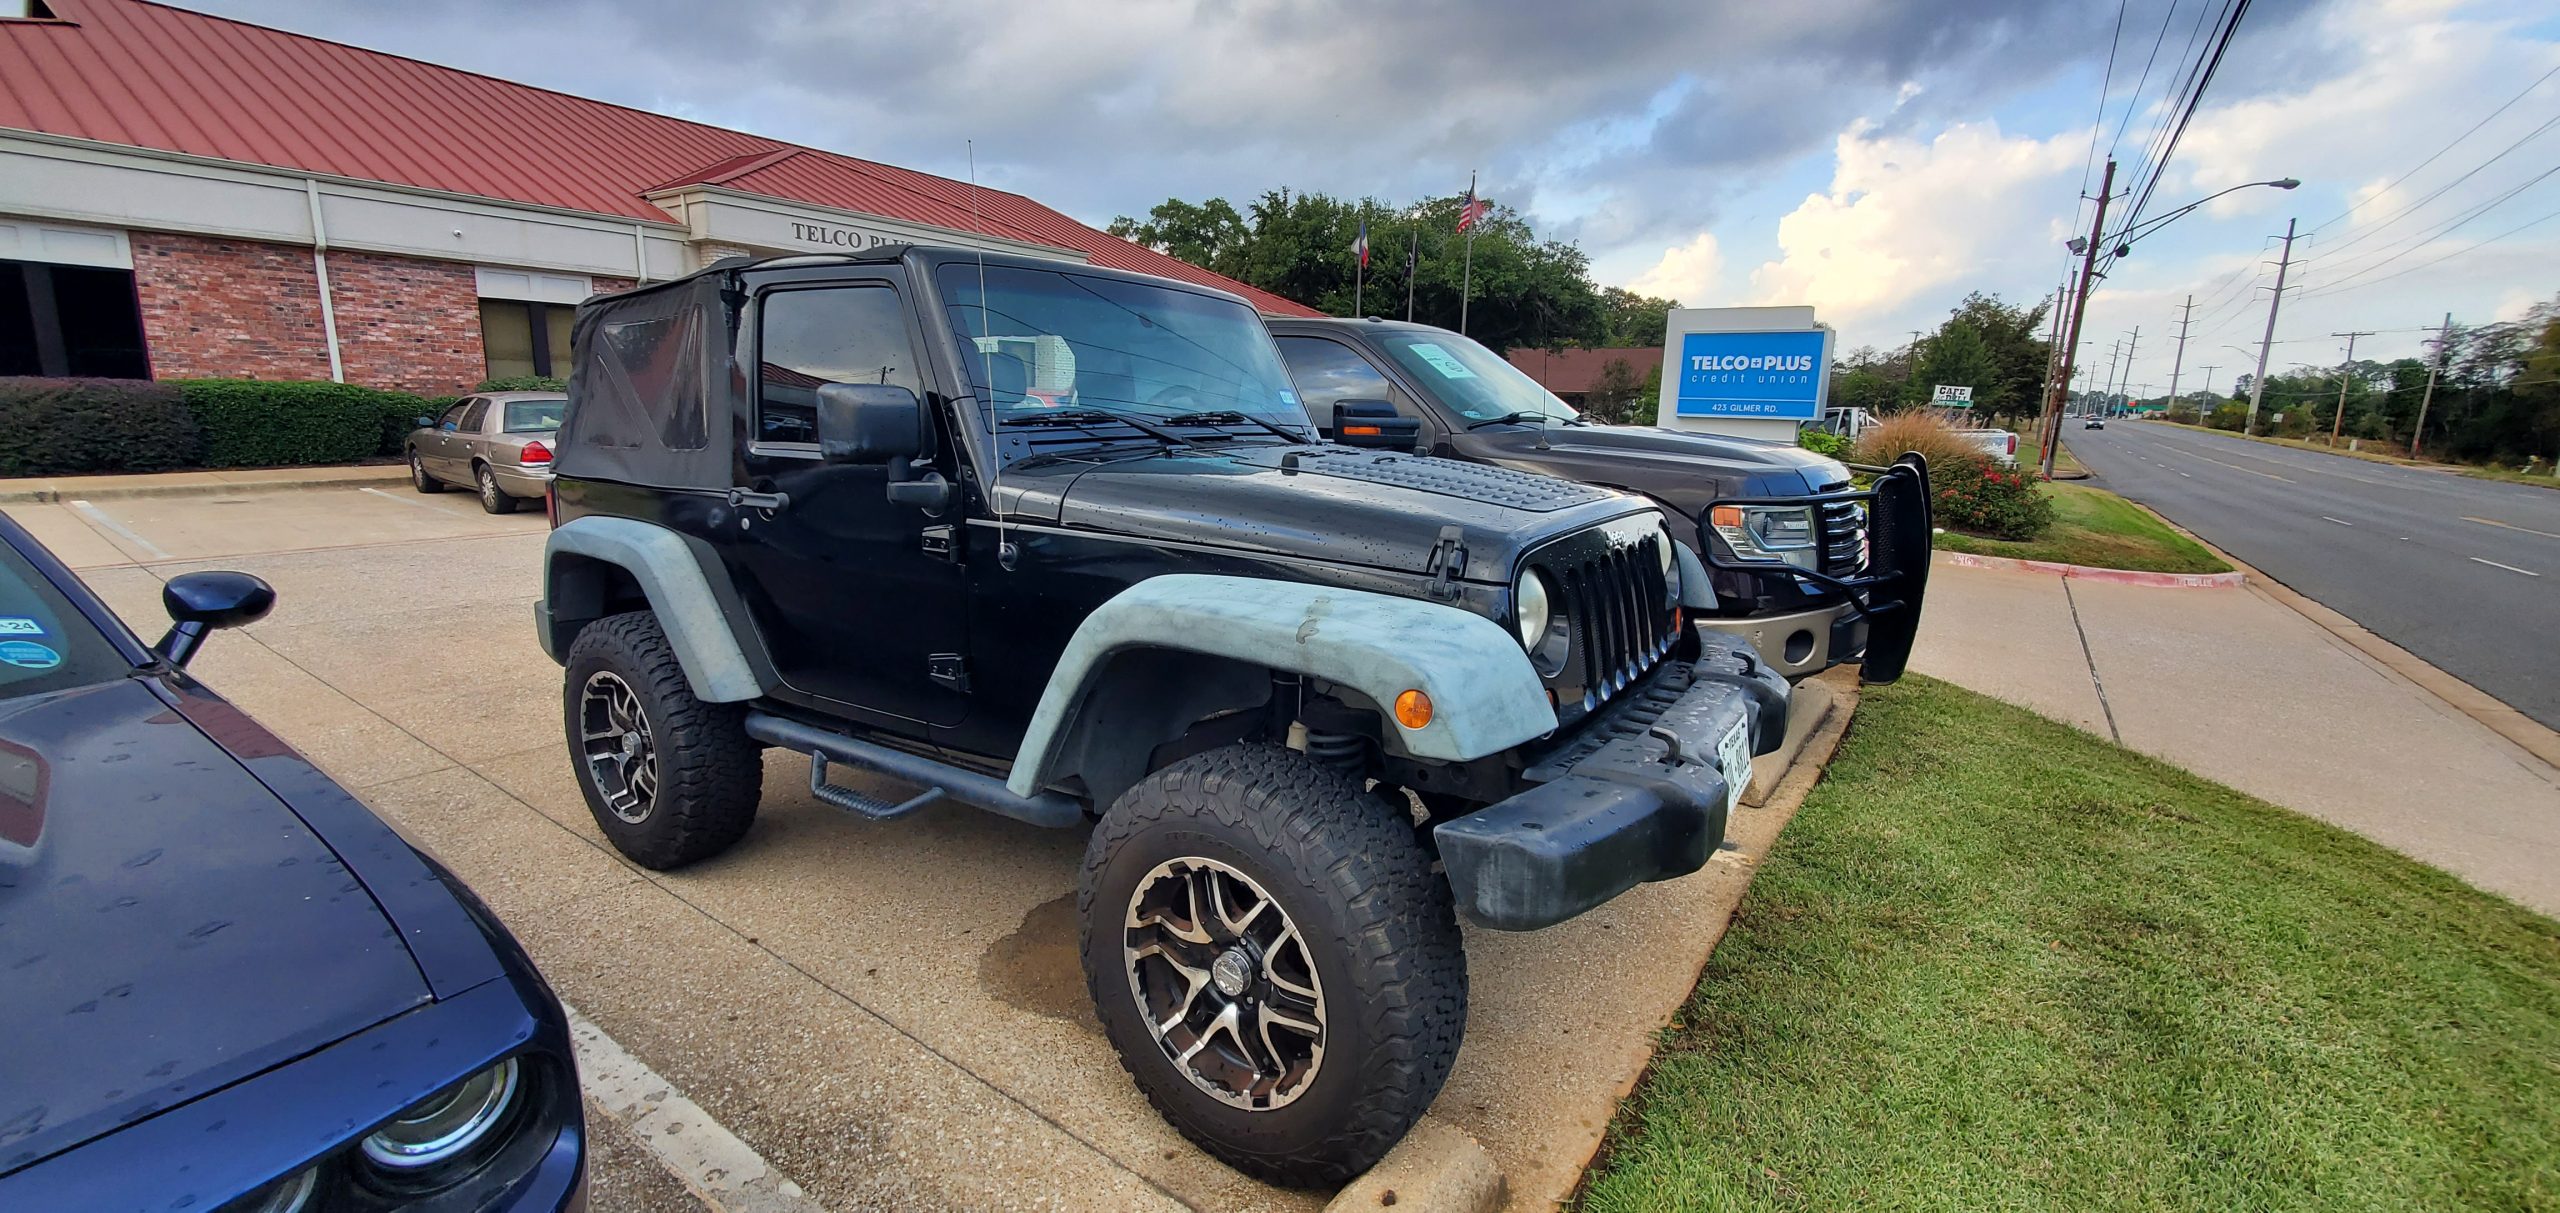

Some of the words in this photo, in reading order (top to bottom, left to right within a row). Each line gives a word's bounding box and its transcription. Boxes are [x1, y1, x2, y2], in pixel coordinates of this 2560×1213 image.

[791, 222, 862, 248] TELCO
[1691, 355, 1750, 371] TELCO
[1763, 355, 1812, 371] PLUS
[1691, 373, 1745, 383] credit
[1758, 374, 1808, 384] union
[1939, 386, 1966, 396] CAFE
[1711, 403, 1727, 412] 423
[1730, 404, 1761, 413] GILMER
[1764, 405, 1778, 413] RD.
[1728, 727, 1741, 750] TEXAS
